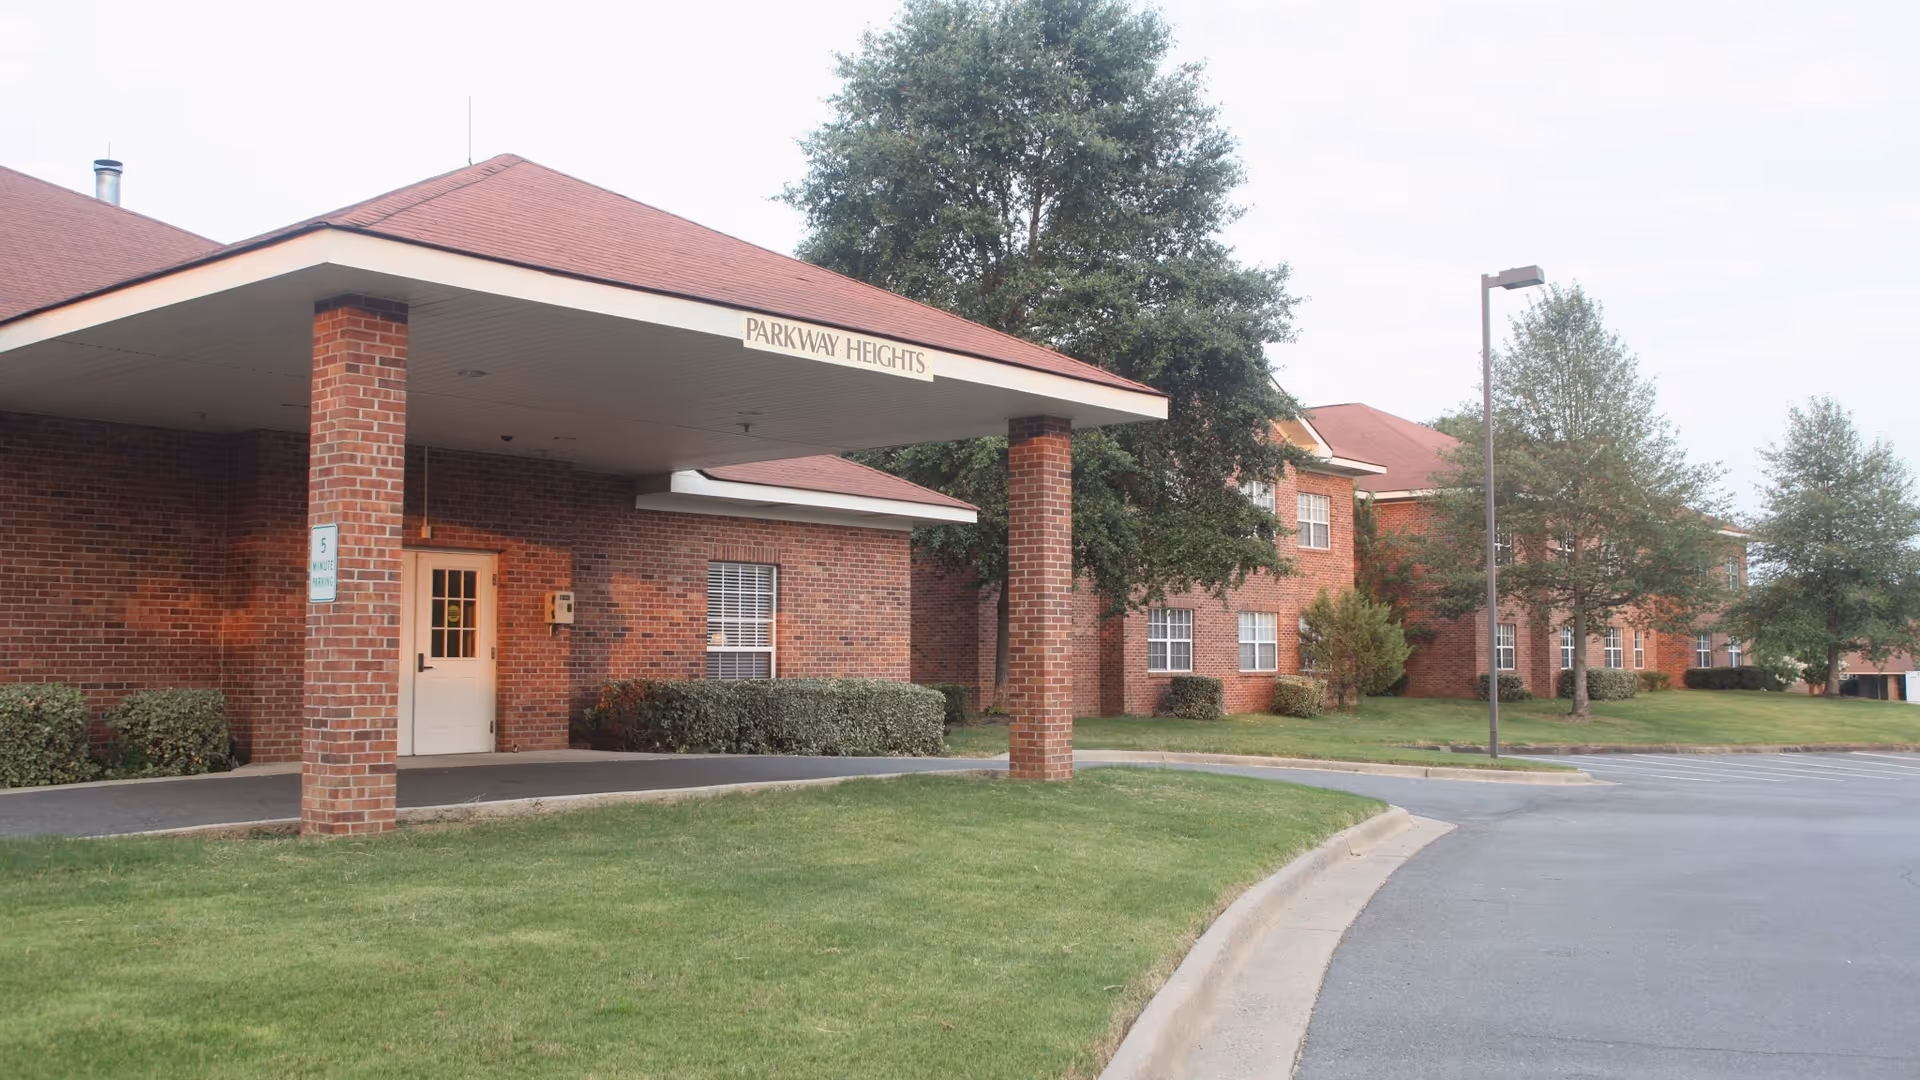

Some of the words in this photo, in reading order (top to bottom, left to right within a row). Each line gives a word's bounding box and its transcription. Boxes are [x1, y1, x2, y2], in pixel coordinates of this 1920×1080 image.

[746, 317, 839, 356] PARKWAY
[847, 338, 925, 373] HEIGHTS
[321, 537, 327, 553] 5
[312, 560, 334, 571] MINUTE
[312, 576, 334, 587] PARKING
